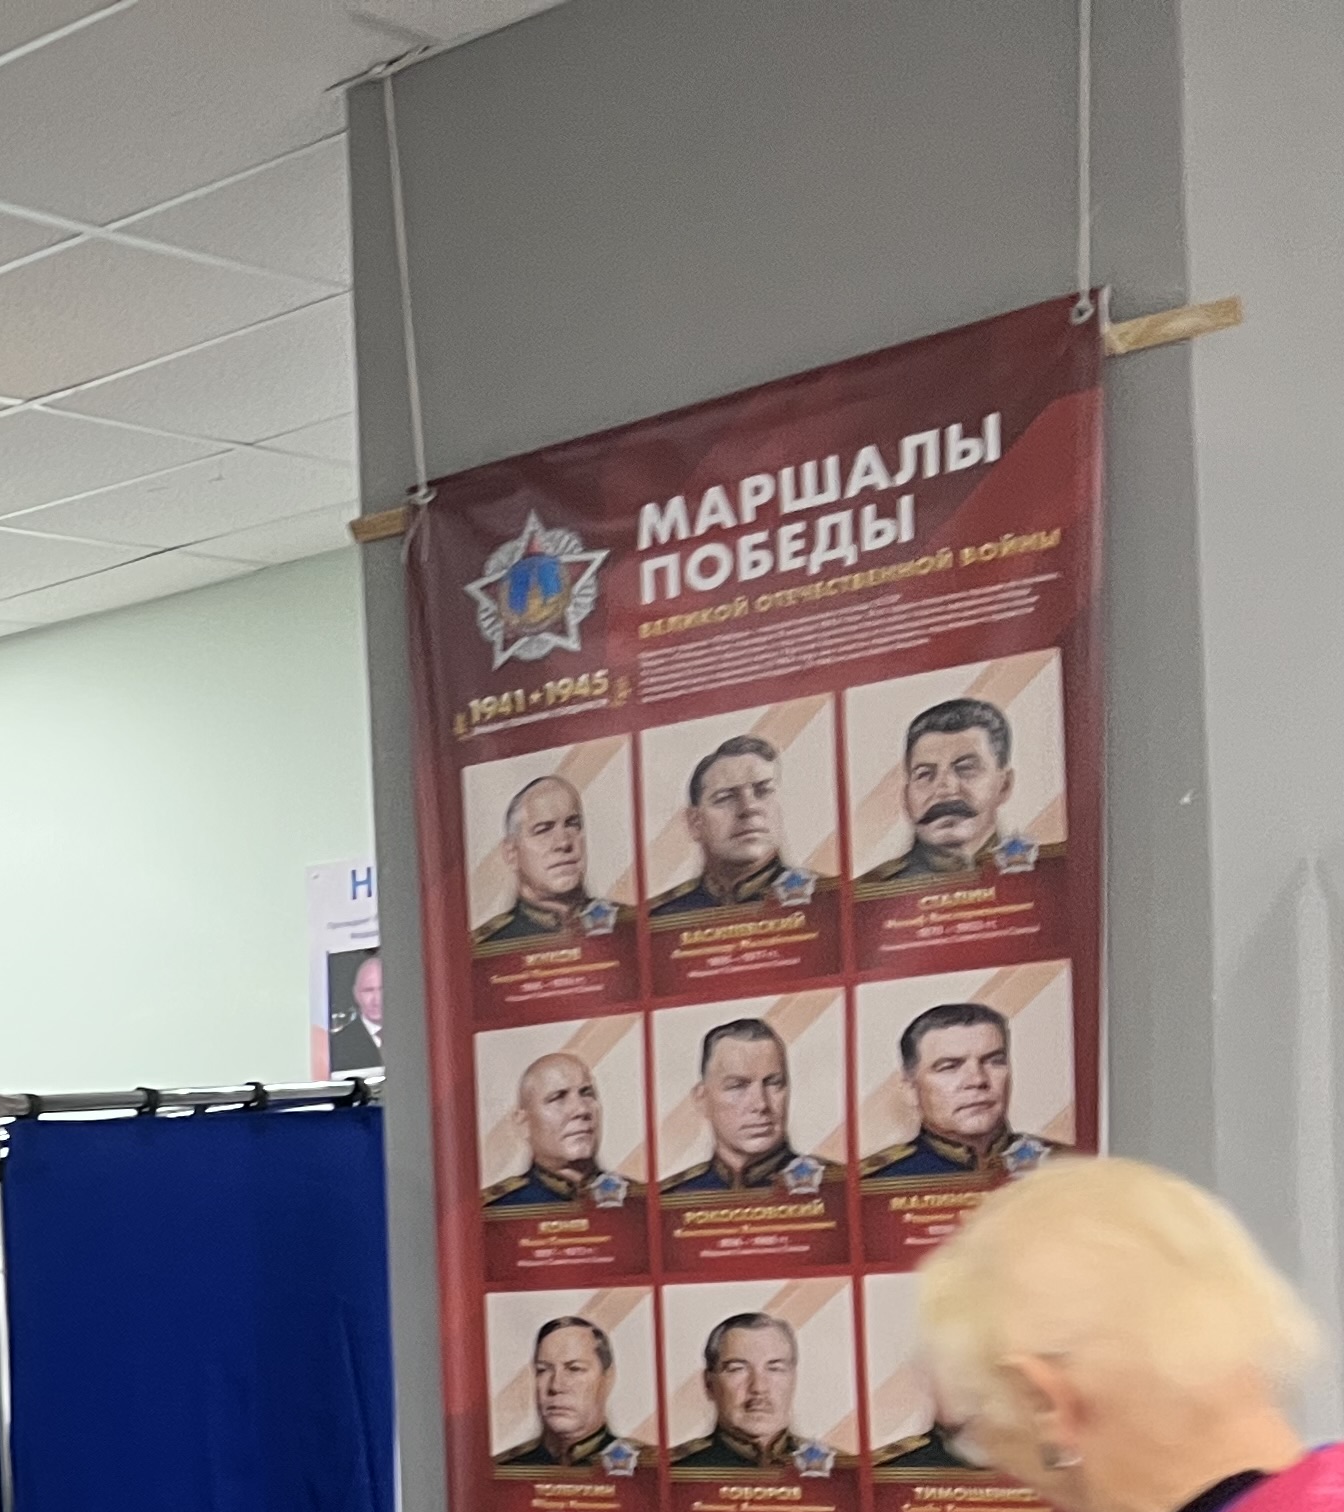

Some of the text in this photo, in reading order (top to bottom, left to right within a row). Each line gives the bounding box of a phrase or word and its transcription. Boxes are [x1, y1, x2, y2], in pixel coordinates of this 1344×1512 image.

[638, 411, 1002, 550] МАРШАЛЫ
[640, 495, 916, 604] ПОБЕДЫ
[468, 669, 609, 724] 1941 1945
